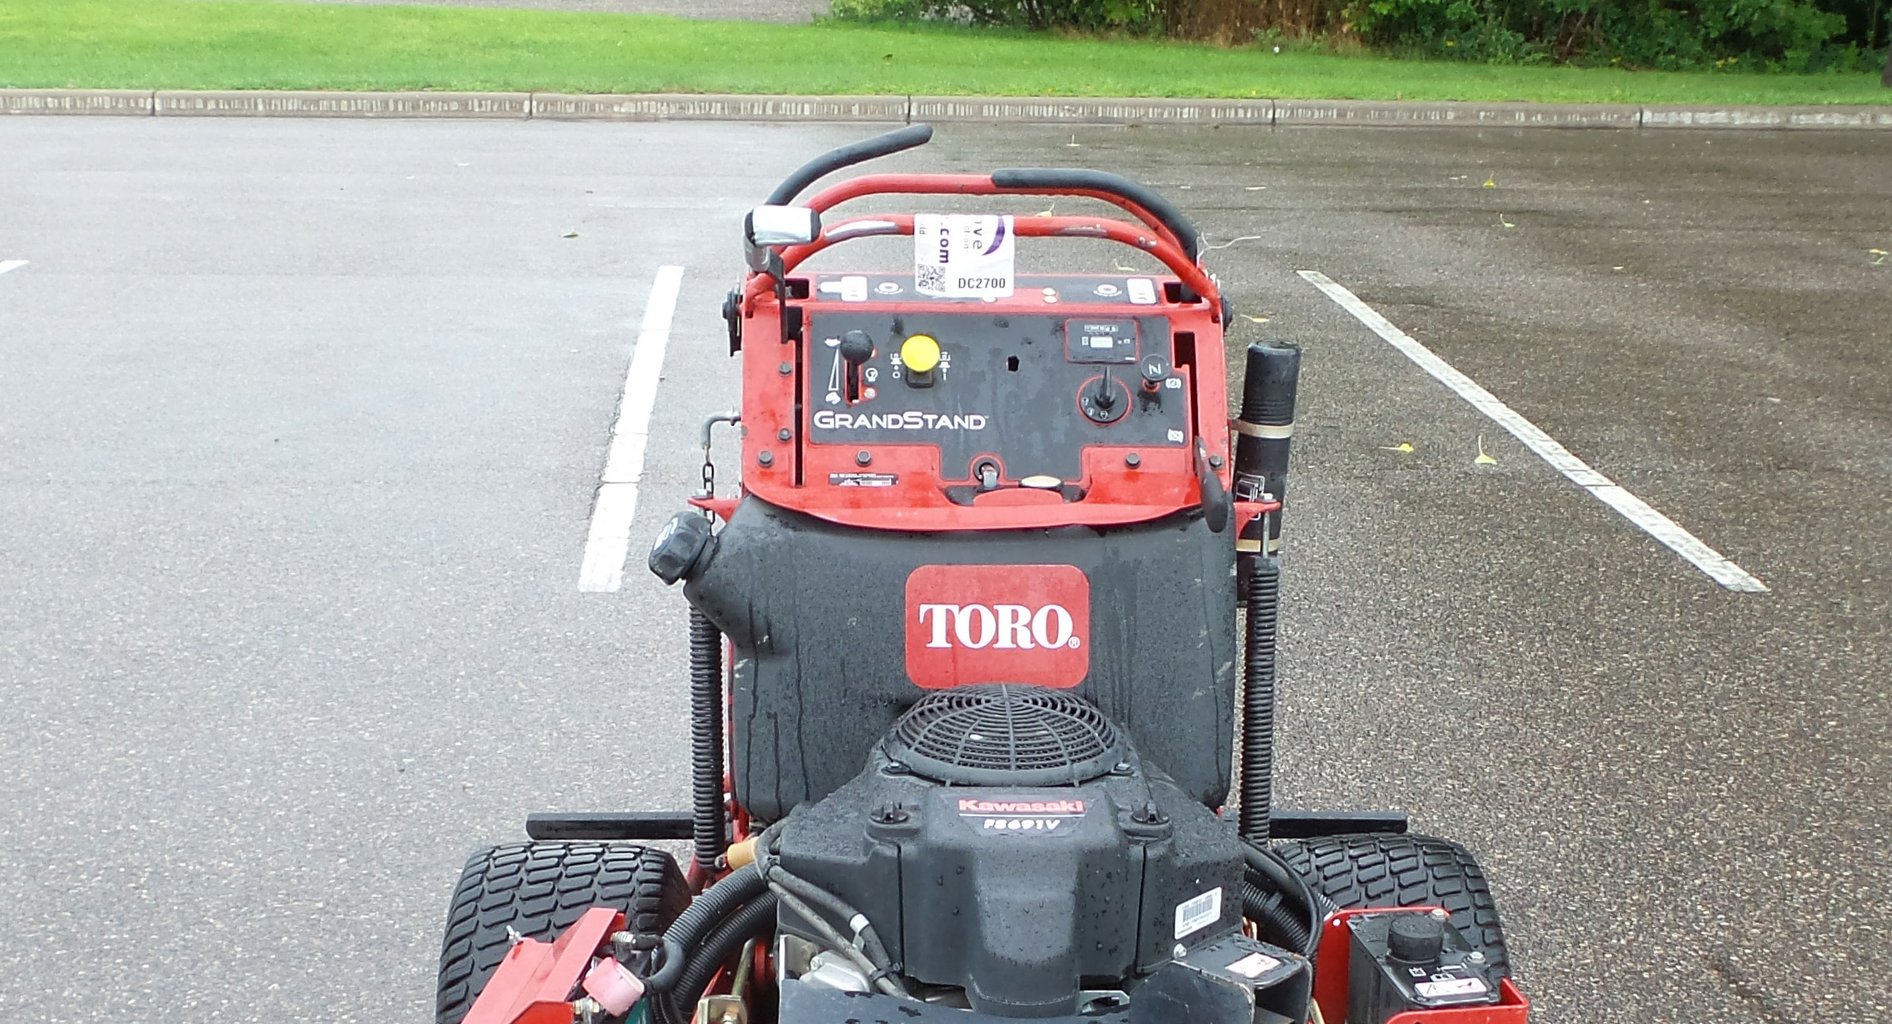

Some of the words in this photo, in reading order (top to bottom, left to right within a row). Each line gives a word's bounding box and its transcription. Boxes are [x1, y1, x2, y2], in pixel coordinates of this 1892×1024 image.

[958, 278, 1006, 289] DC2700
[919, 603, 1074, 649] TORO
[958, 799, 1086, 812] Kawasaki
